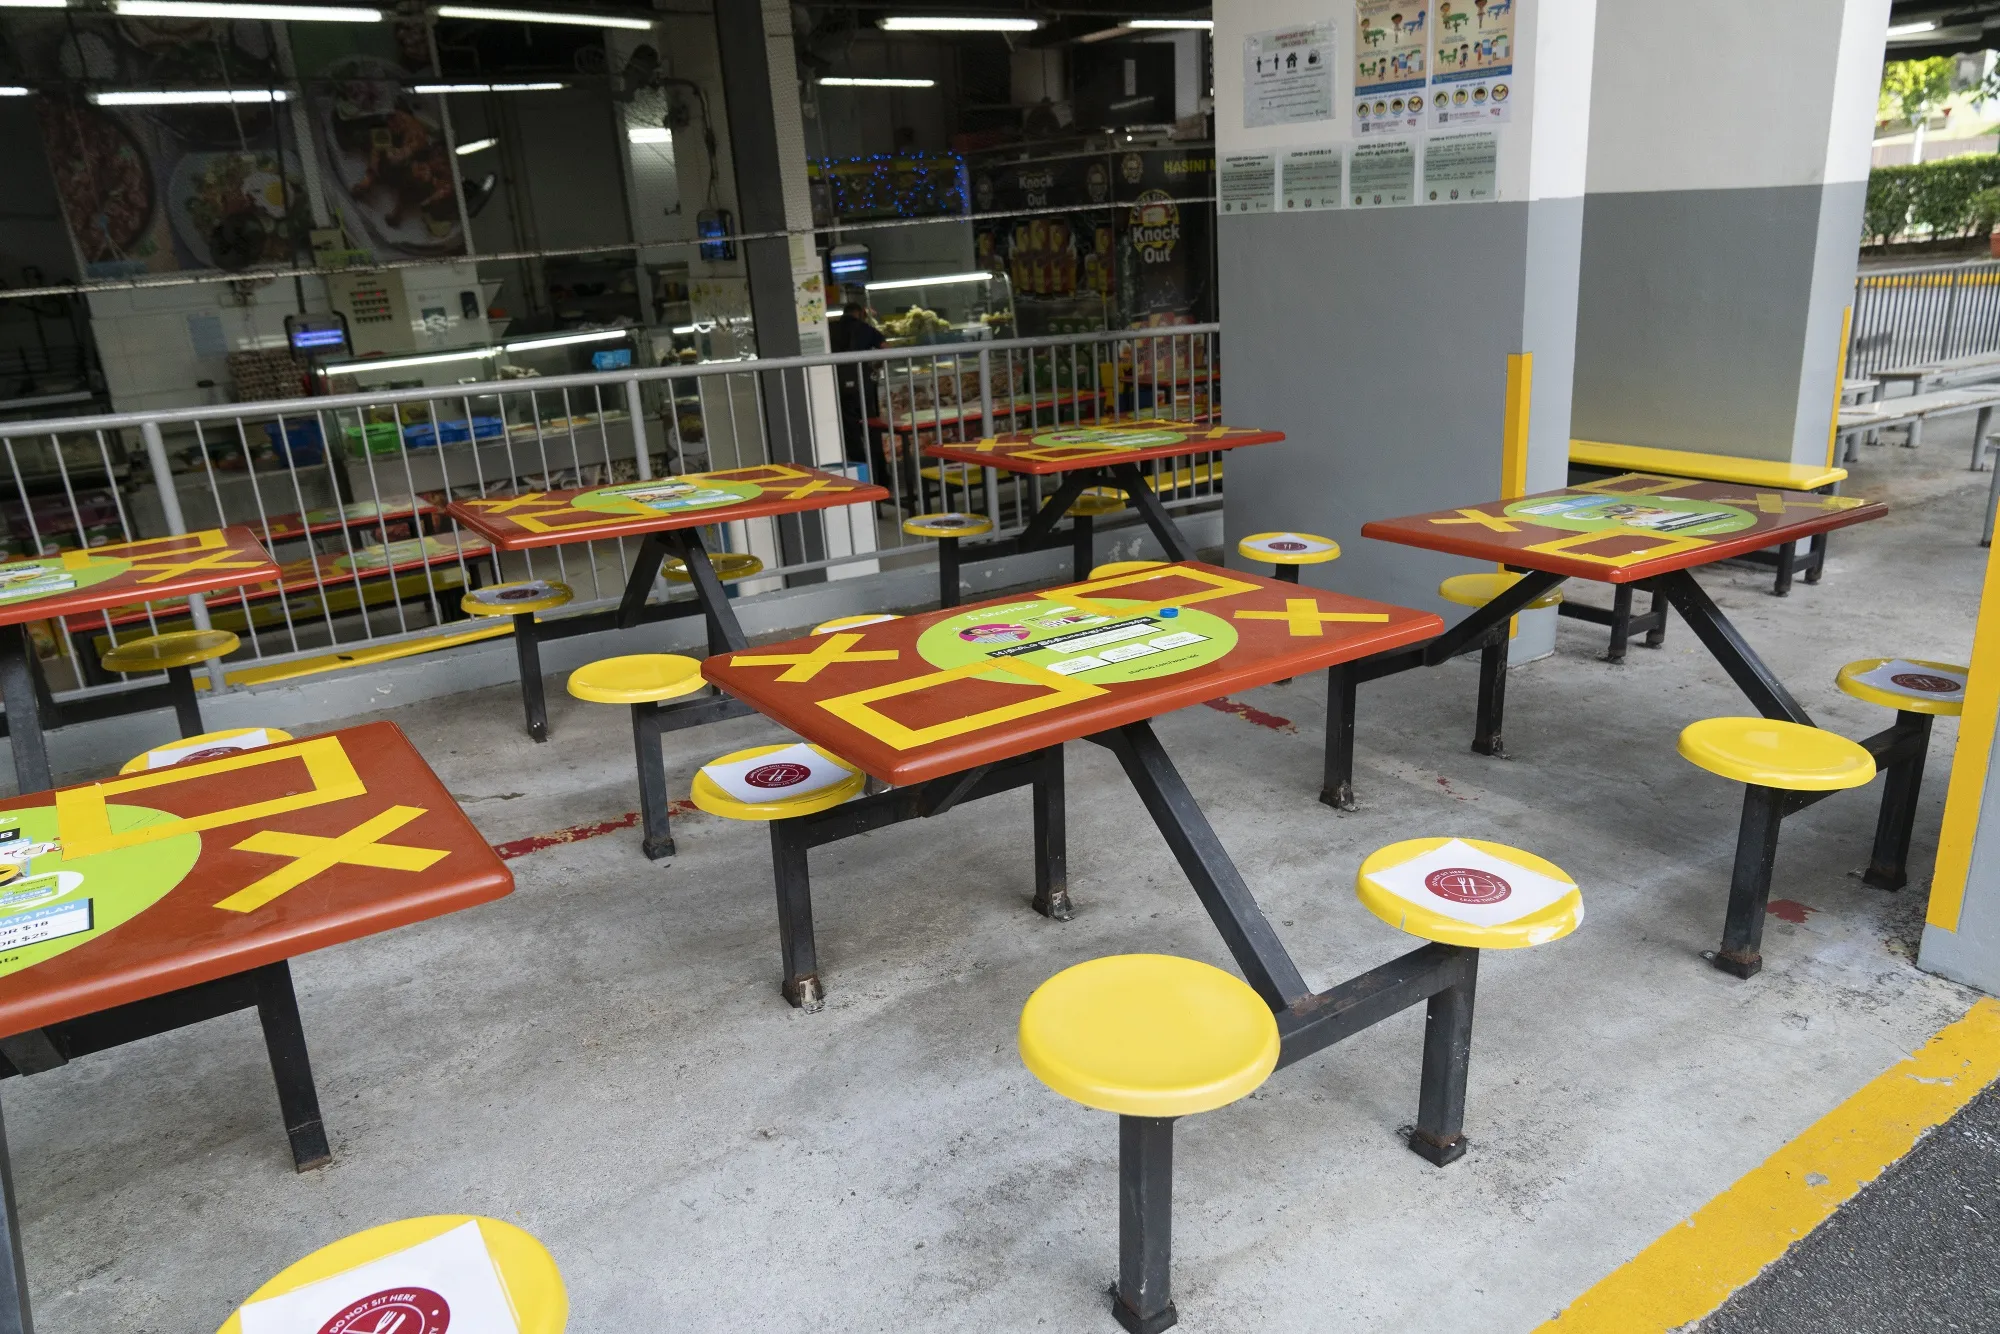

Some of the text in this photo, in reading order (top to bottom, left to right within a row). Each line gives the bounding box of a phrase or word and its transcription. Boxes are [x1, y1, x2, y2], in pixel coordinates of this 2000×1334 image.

[1164, 160, 1206, 174] HASINI
[1019, 174, 1053, 190] Knock
[1027, 192, 1046, 206] Out
[1133, 224, 1180, 242] Knock
[1144, 247, 1171, 264] Out
[36, 904, 75, 918] PLAN
[23, 921, 48, 930] $18
[22, 932, 48, 942] $25
[329, 1294, 416, 1334] DO NOT SIT HERE
